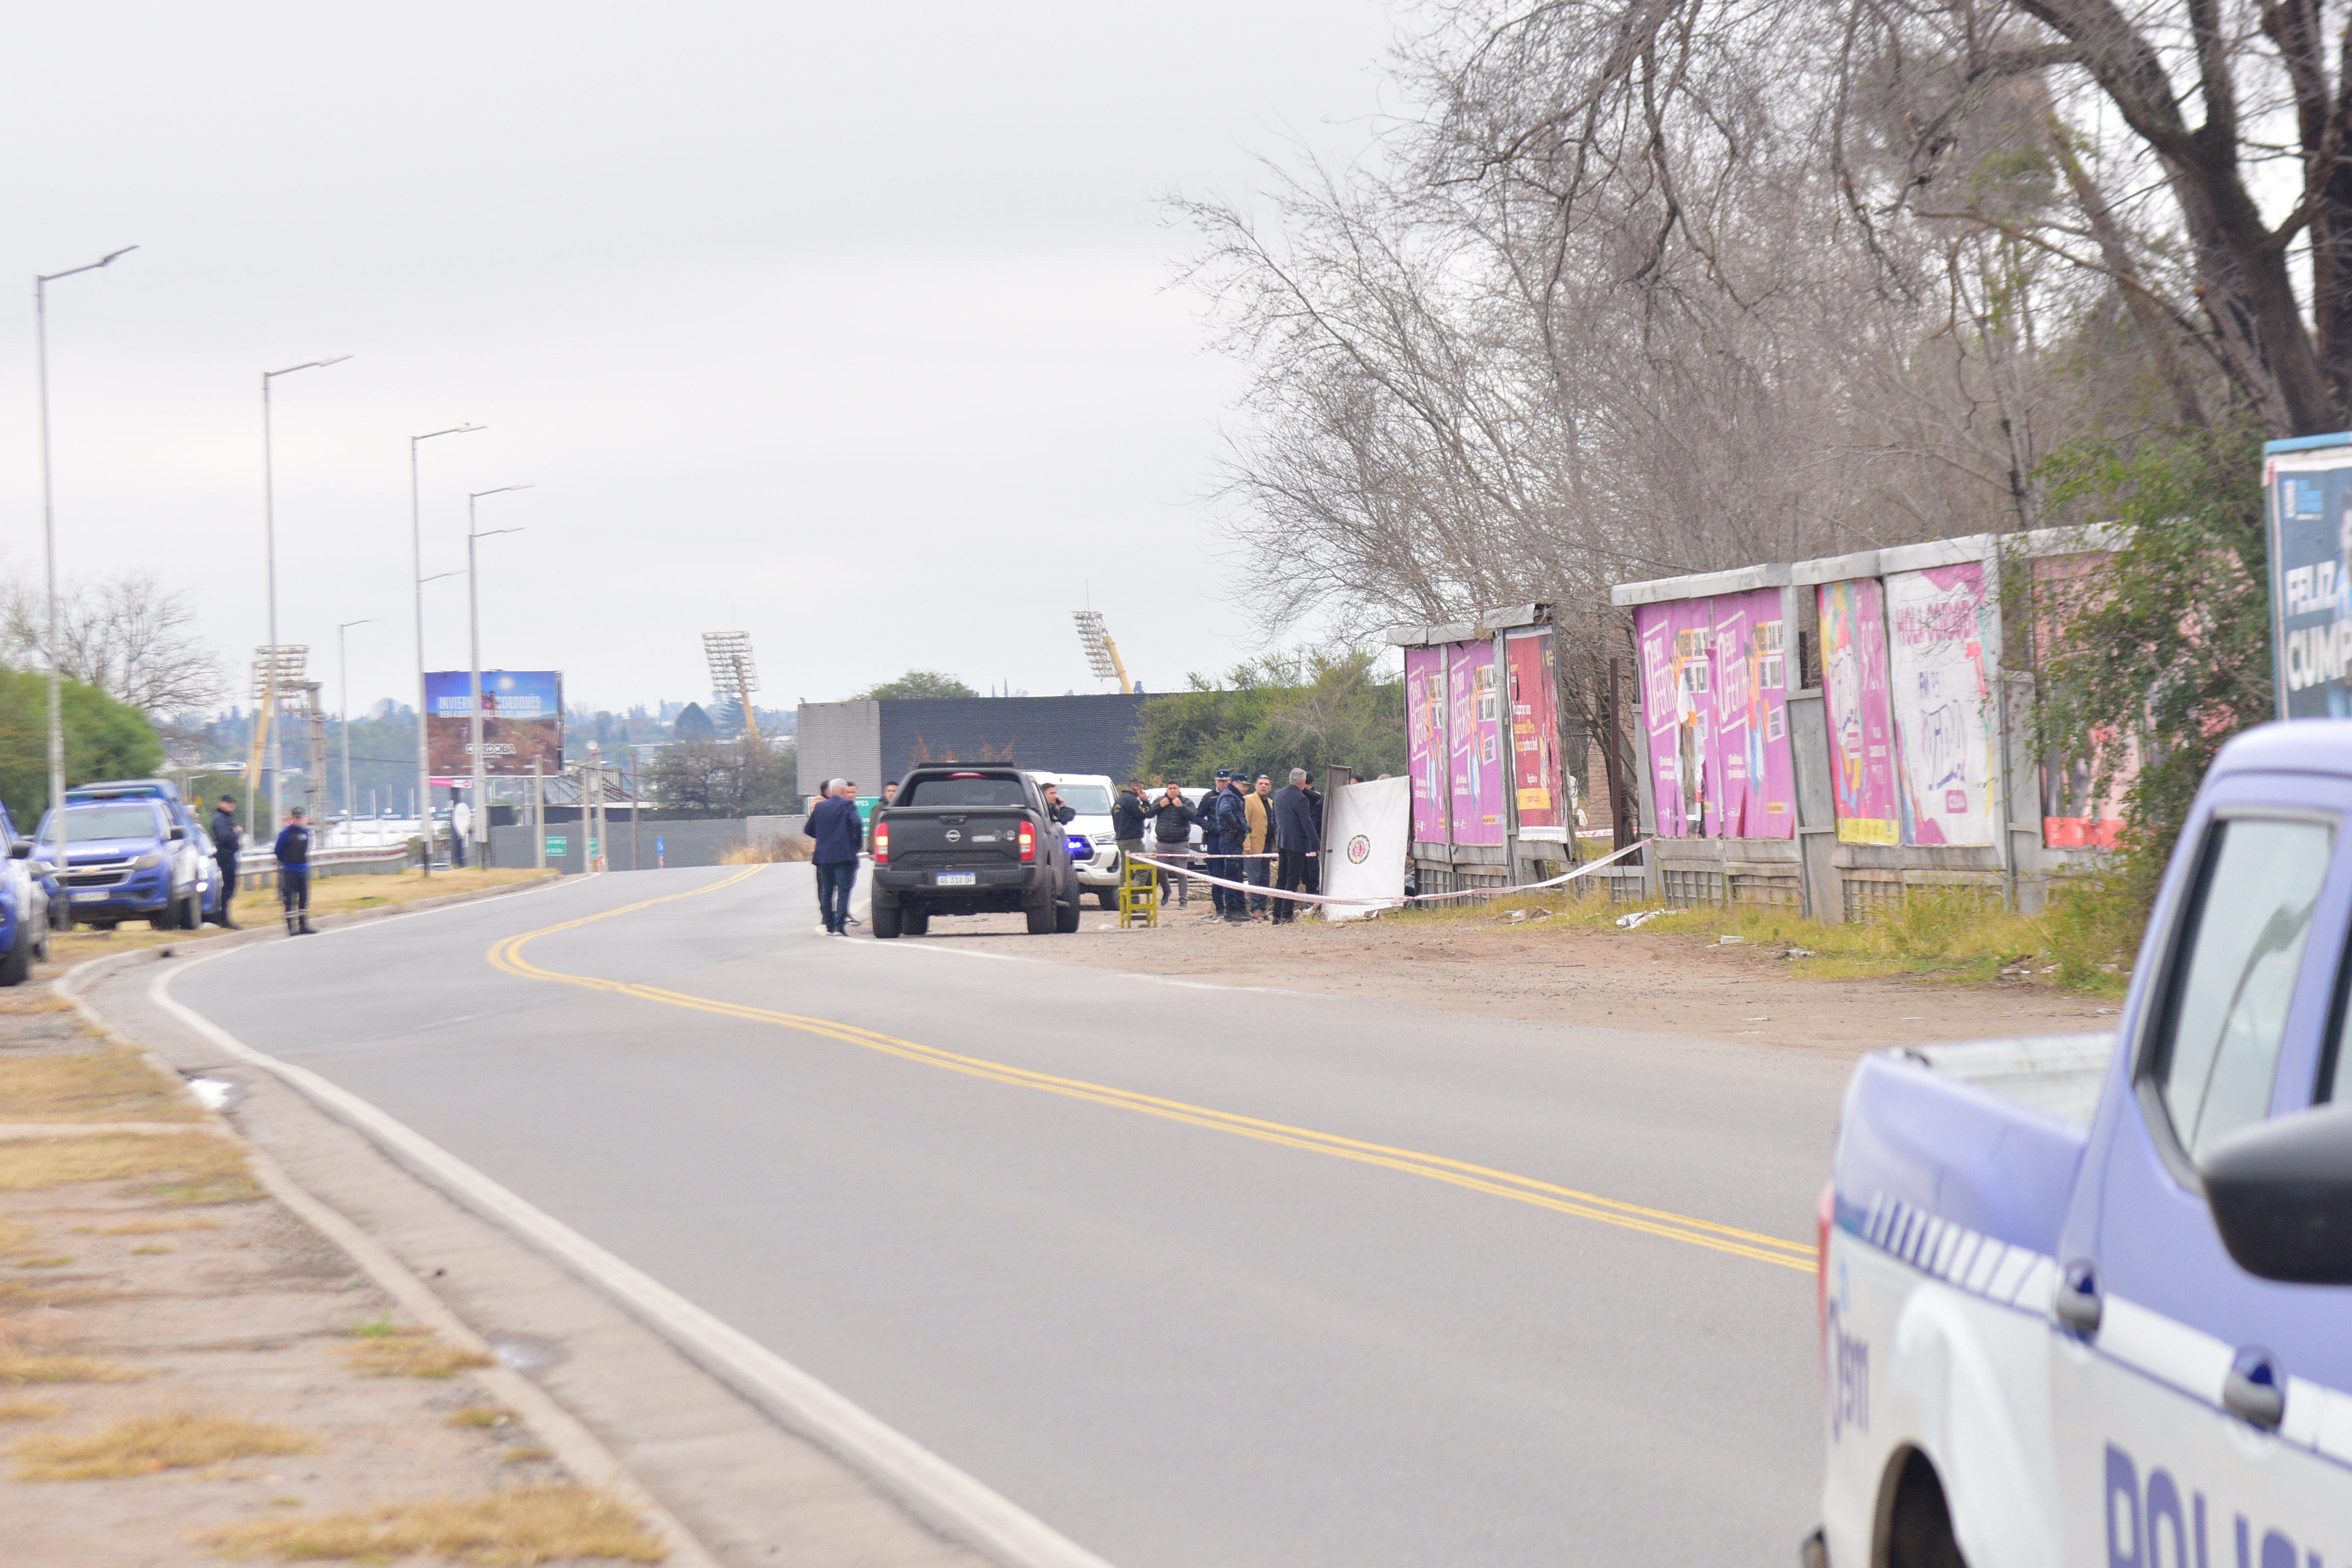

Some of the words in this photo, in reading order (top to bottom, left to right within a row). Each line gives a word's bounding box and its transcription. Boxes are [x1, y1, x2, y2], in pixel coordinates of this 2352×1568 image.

[2286, 560, 2337, 618] FELIZ
[439, 696, 474, 710] INVIERN
[466, 743, 516, 755] CRDOBA
